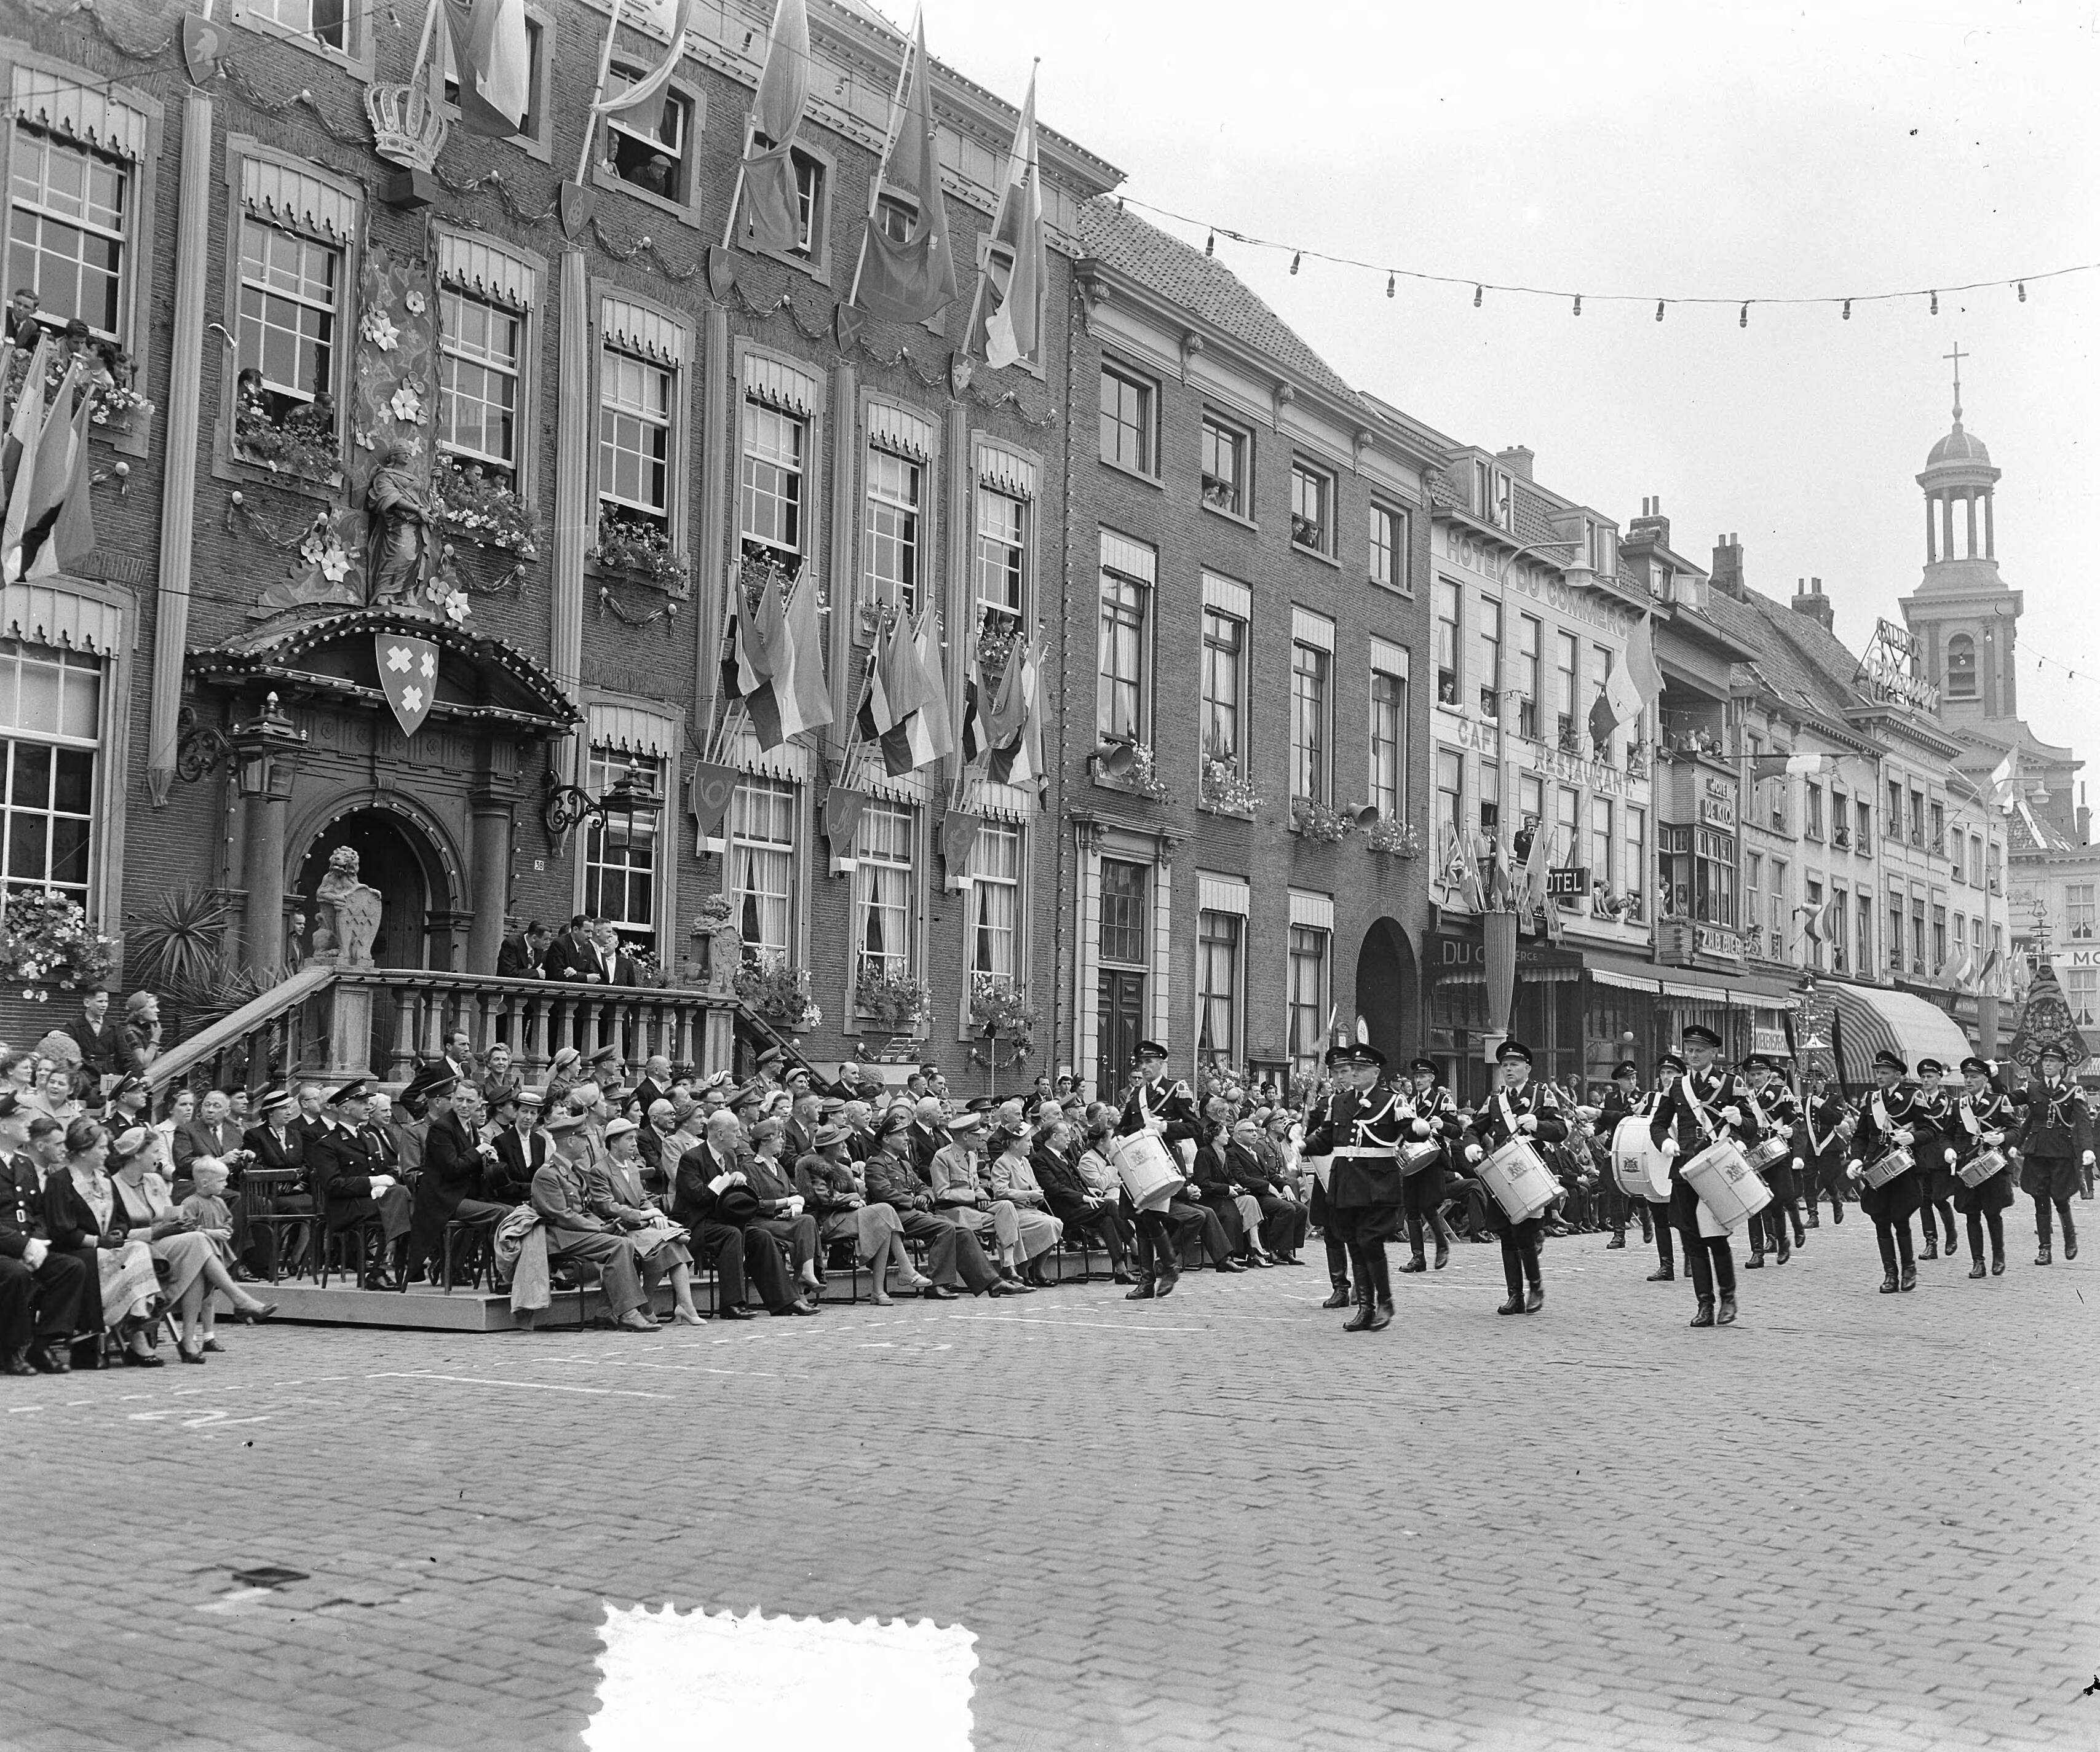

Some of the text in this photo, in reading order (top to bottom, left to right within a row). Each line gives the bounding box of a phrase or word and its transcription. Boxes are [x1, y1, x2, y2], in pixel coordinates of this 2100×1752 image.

[1447, 531, 1509, 585] HOTEL
[1516, 563, 1540, 598] DU
[1705, 799, 1716, 819] DE
[536, 861, 543, 870] 38
[1546, 873, 1582, 892] OTEL
